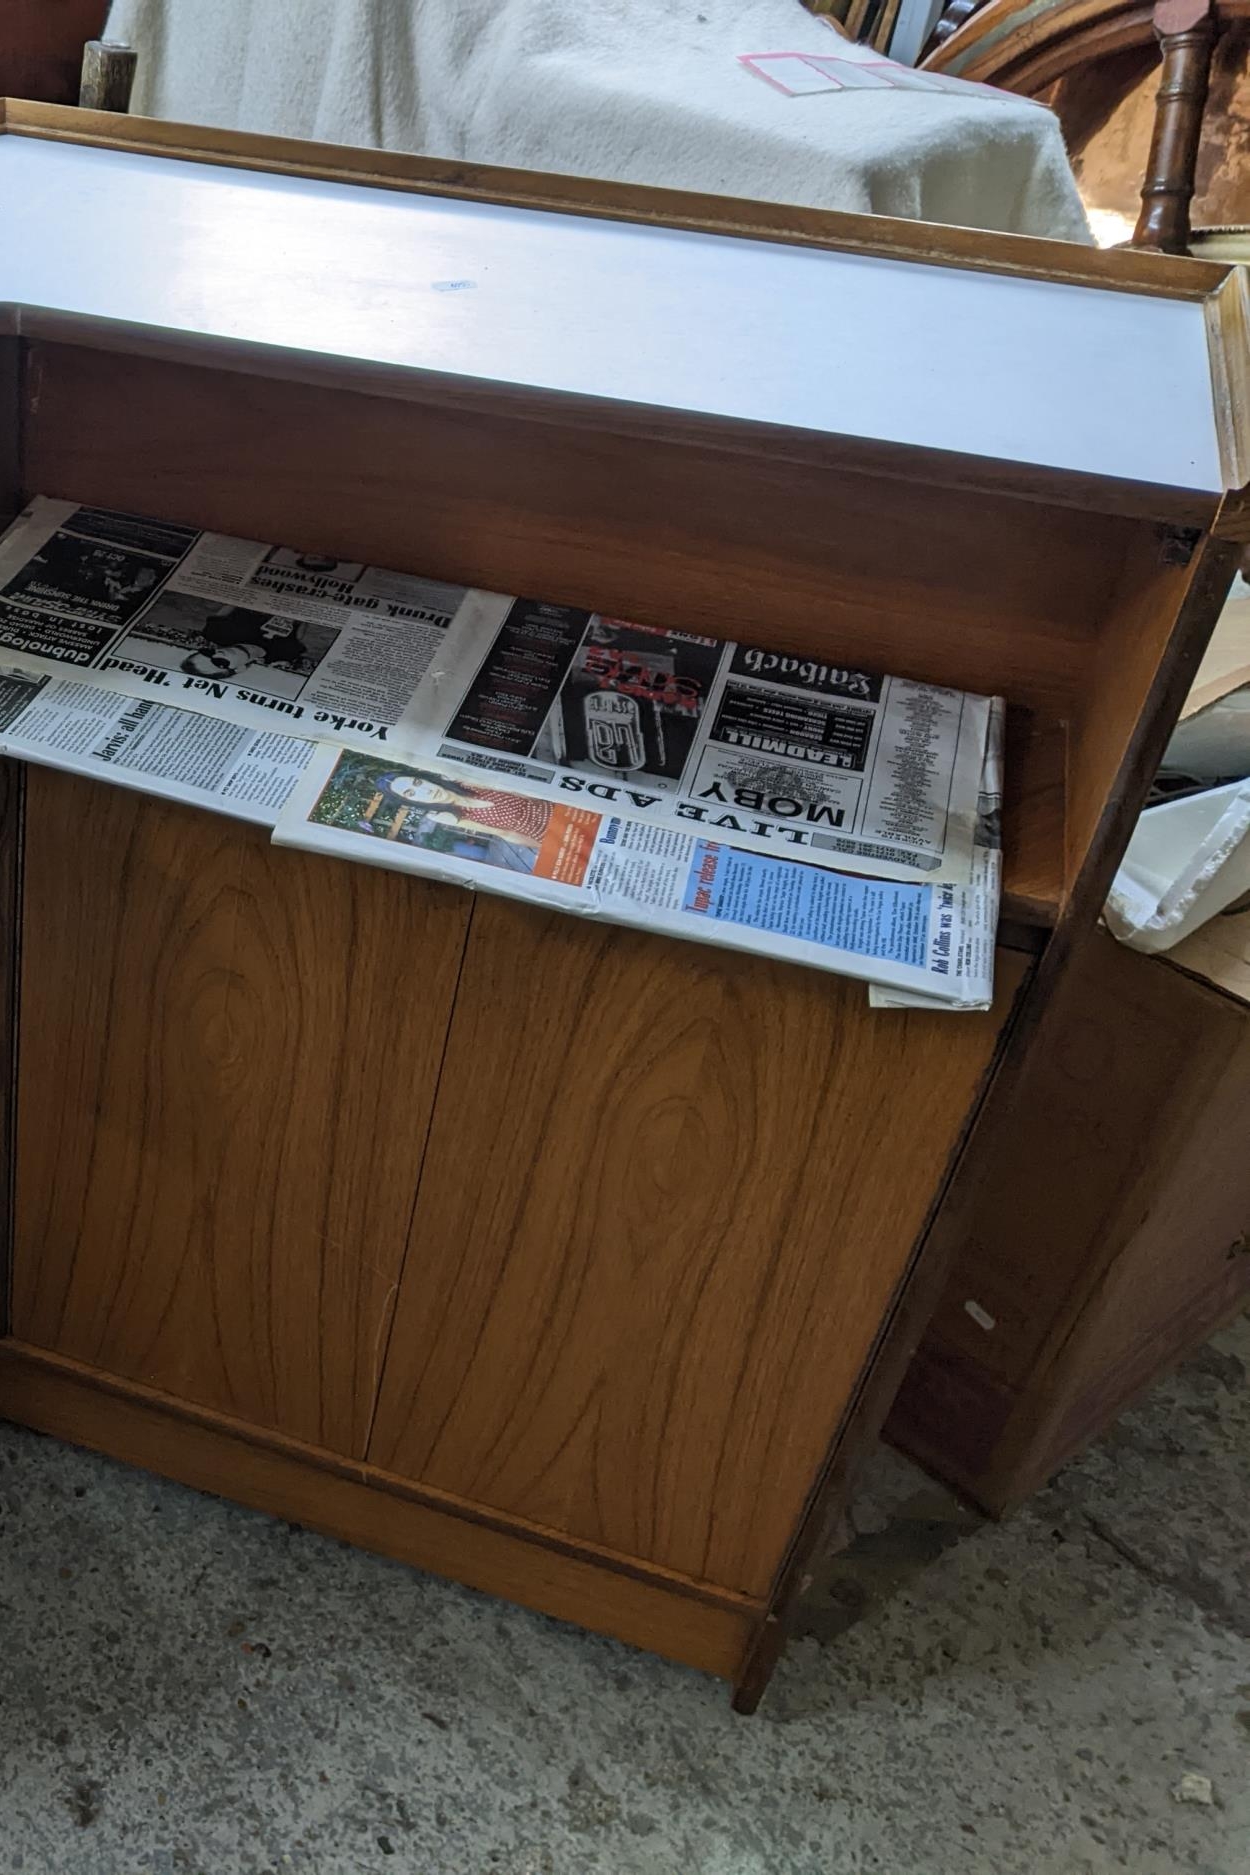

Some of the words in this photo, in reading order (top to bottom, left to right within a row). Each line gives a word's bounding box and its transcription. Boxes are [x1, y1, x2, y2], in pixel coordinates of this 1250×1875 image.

[24, 585, 72, 599] SUNSHINE
[255, 563, 354, 595] Hollywood
[71, 595, 88, 604] THE
[249, 574, 379, 612] gate-crashes
[9, 620, 35, 630] DREAD
[385, 602, 452, 631] Drunk
[28, 631, 57, 642] ATTACK
[44, 629, 100, 645] UNDERWORLD
[58, 638, 93, 649] MASSIVE
[743, 649, 871, 695] Laibach
[180, 674, 228, 700] Net
[235, 688, 305, 719] turns
[312, 708, 390, 742] Yorke
[92, 730, 129, 762] Jarvis:
[118, 717, 139, 733] all
[560, 773, 663, 808] ADS
[696, 780, 845, 827] MOBY
[676, 801, 810, 846] LIVE
[855, 849, 907, 862] ADVERTISE
[695, 854, 719, 885] release
[685, 886, 714, 913] Tupac
[939, 913, 953, 928] was
[932, 930, 952, 957] Collins
[931, 959, 949, 975] Rob
